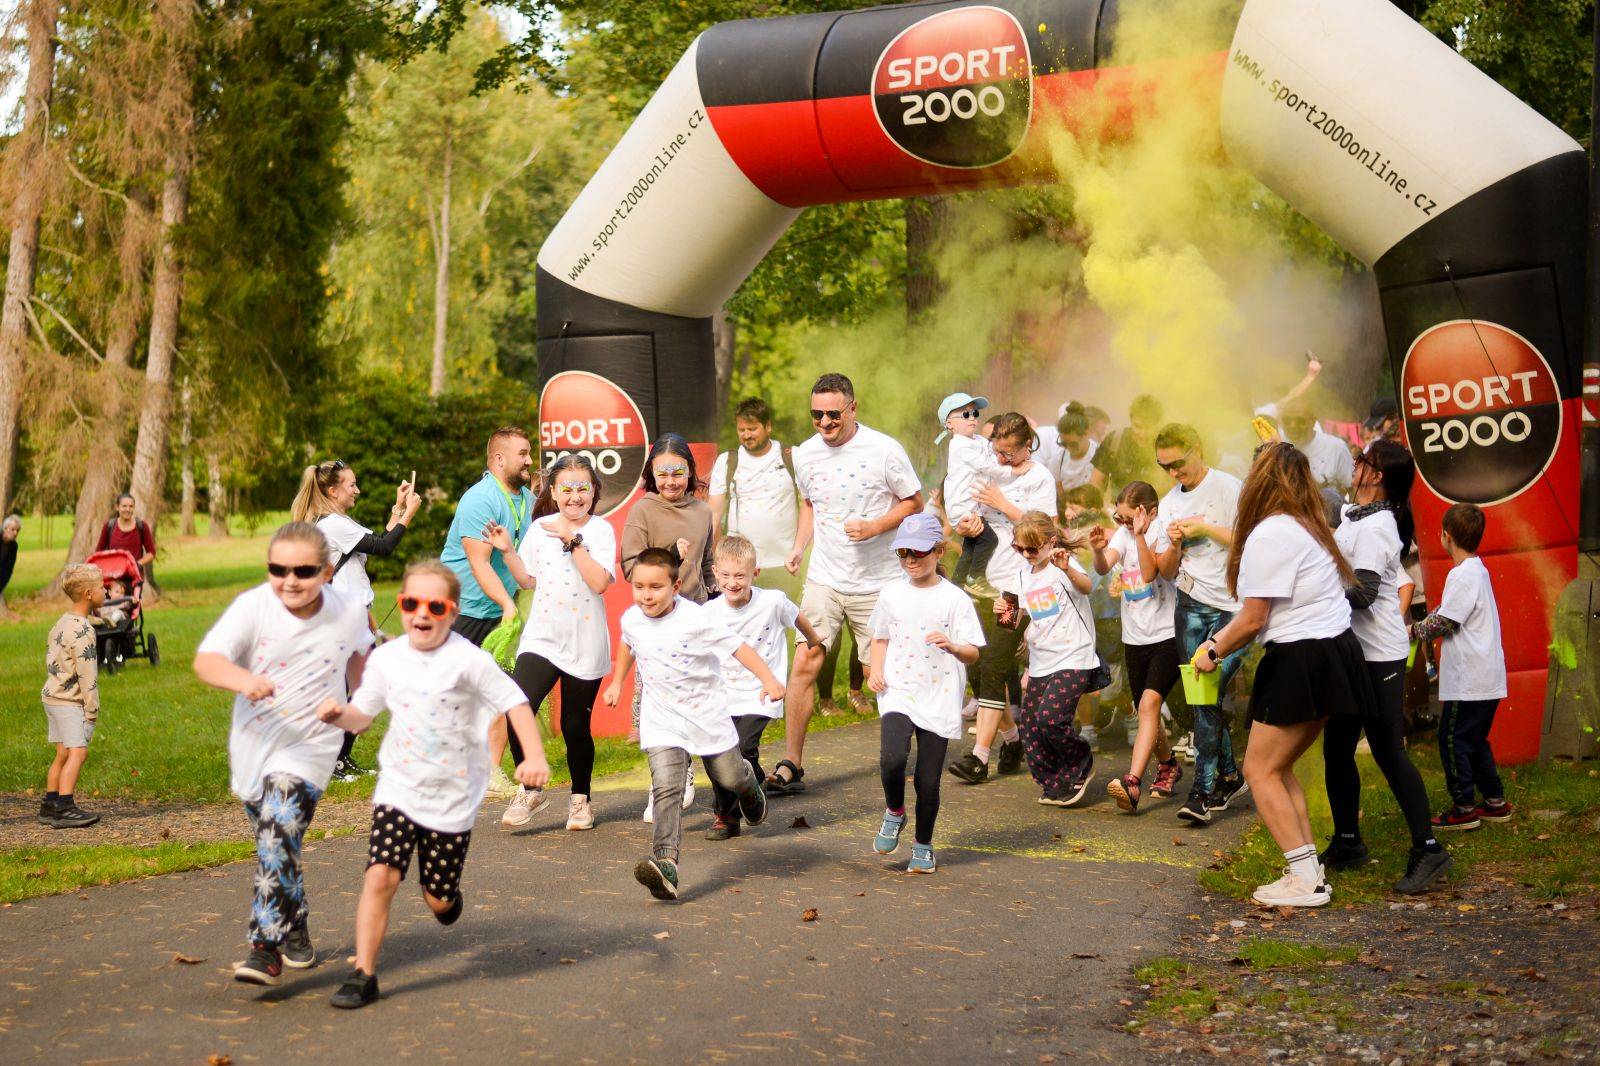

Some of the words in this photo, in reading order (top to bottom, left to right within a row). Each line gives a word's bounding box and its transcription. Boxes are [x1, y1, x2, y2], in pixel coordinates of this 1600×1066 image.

[887, 44, 1016, 89] SPORT
[900, 86, 1006, 126] 2000
[1233, 48, 1438, 216] www.sport2000online.cz
[567, 109, 705, 281] www.sport2000online.cz
[1408, 370, 1538, 416] SPORT
[540, 417, 632, 447] SPORT
[1421, 411, 1532, 453] 2000
